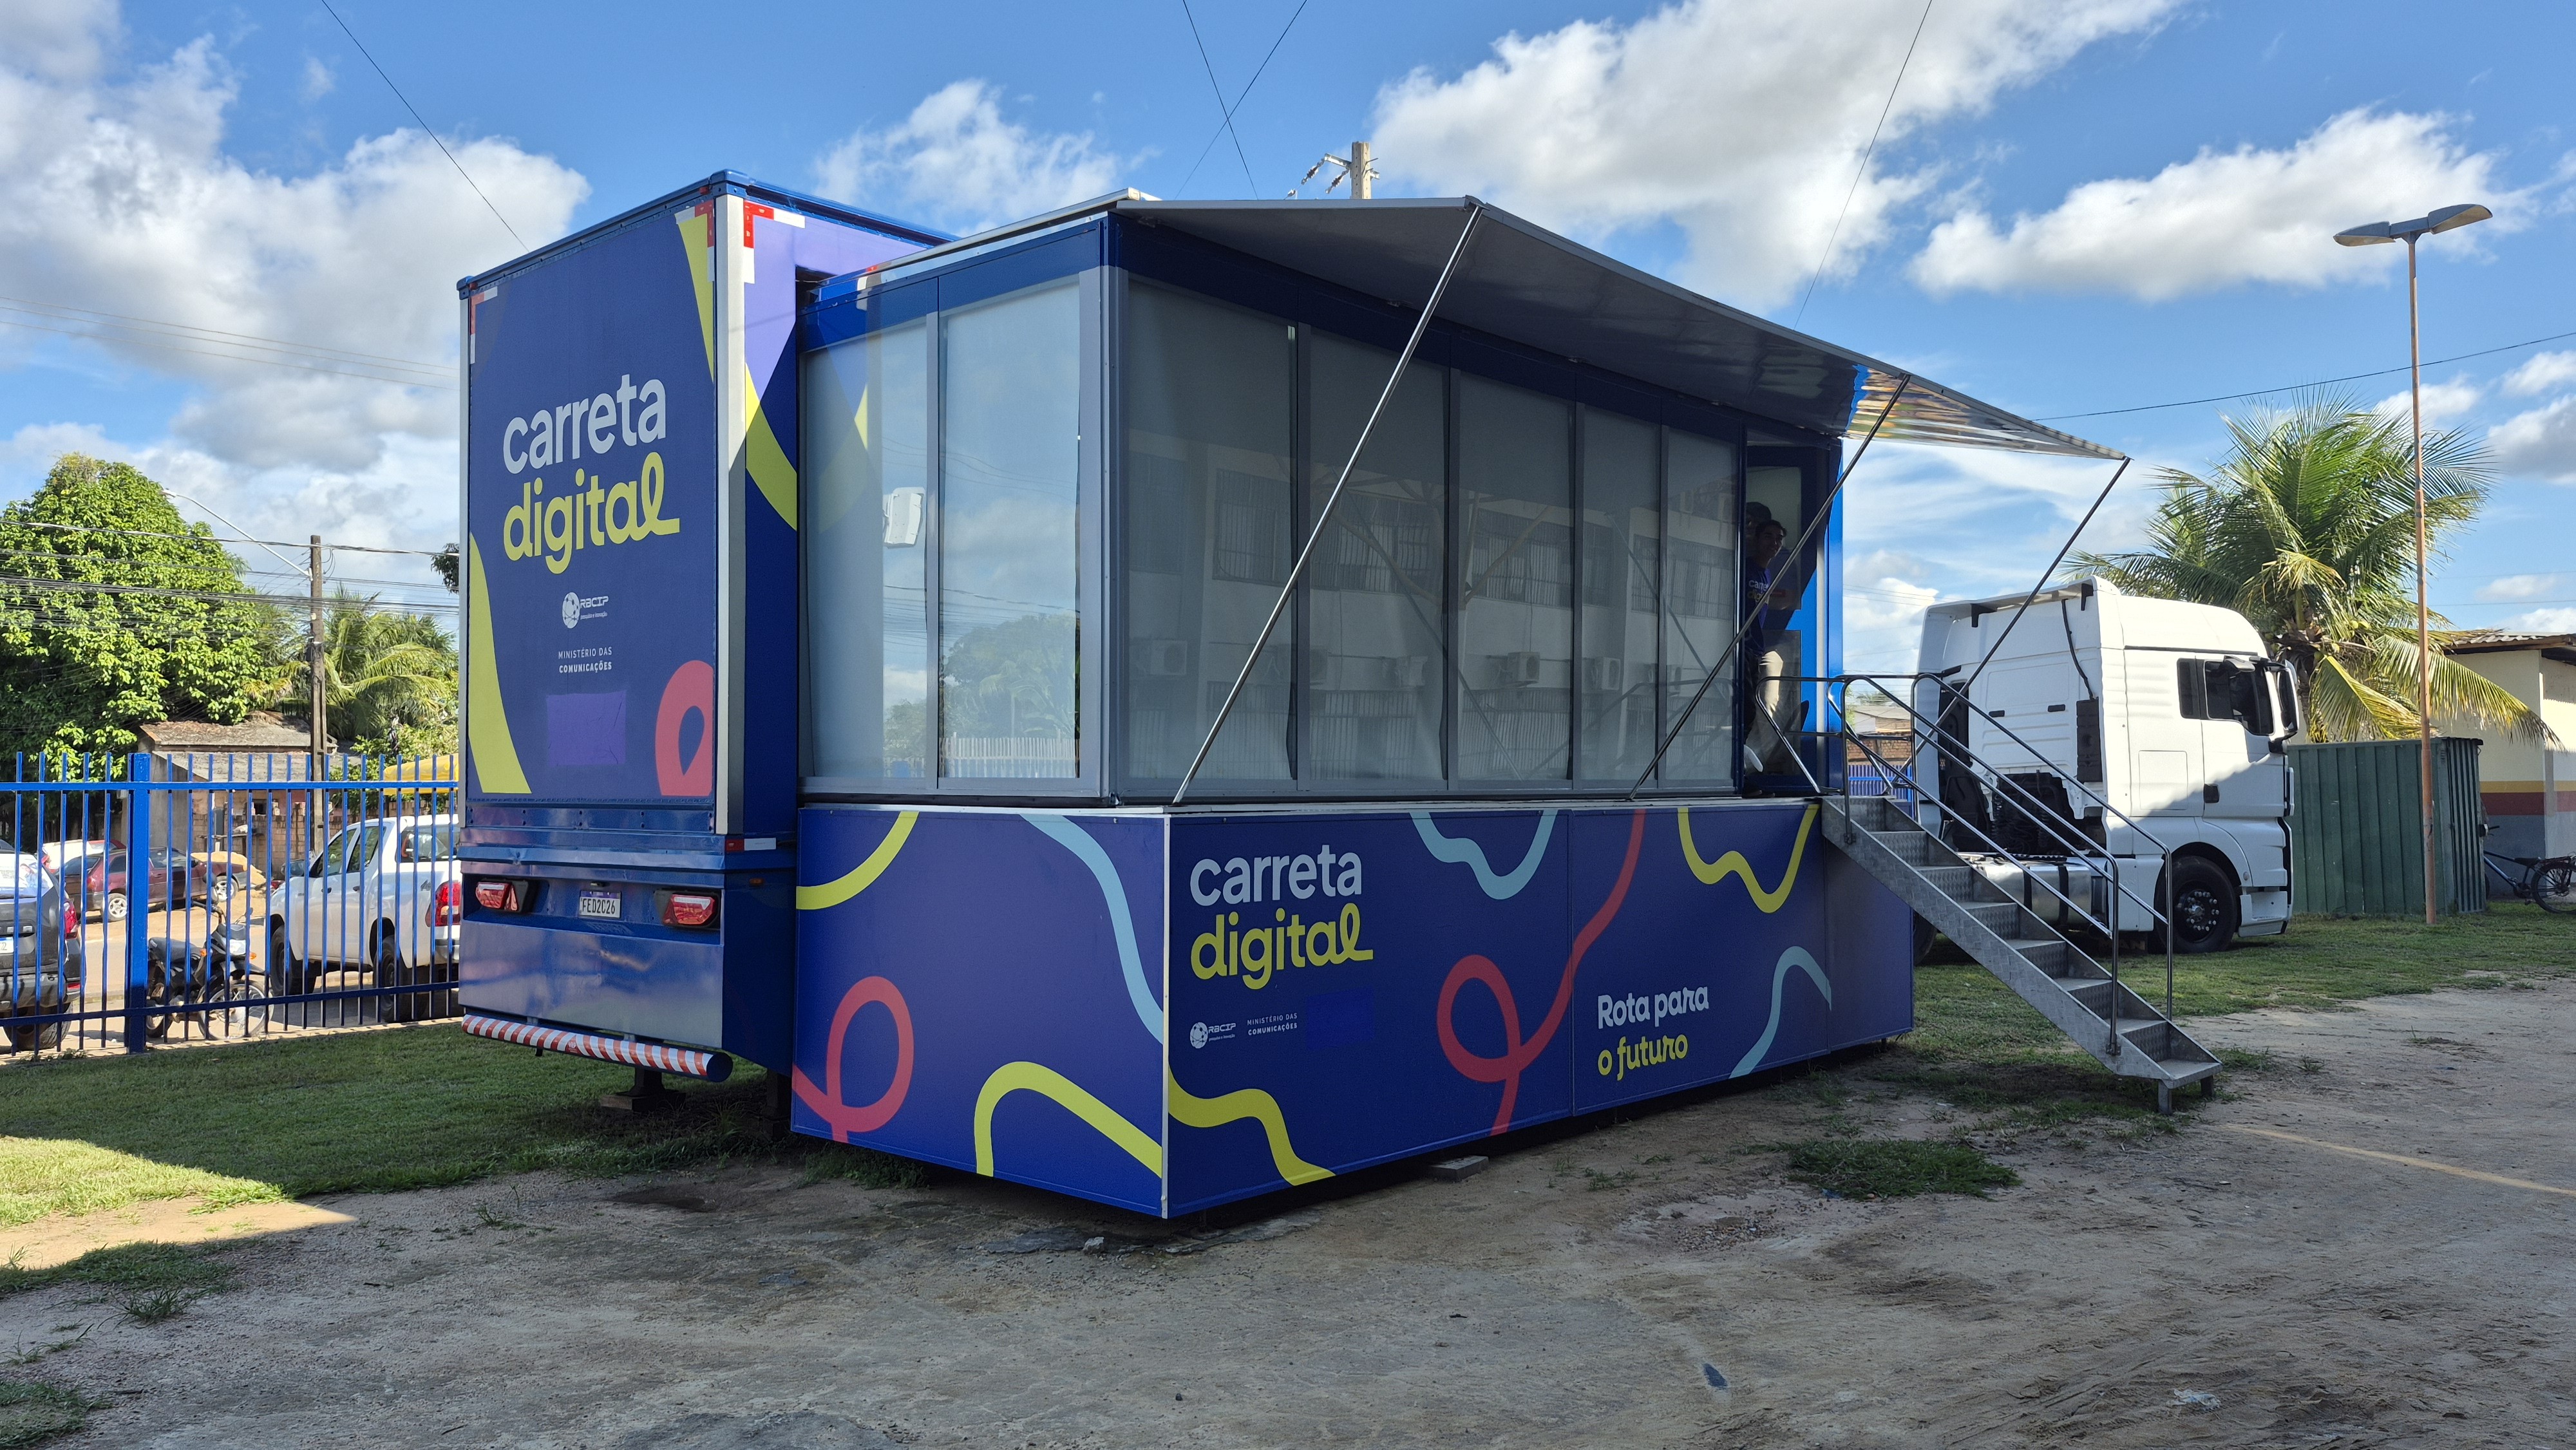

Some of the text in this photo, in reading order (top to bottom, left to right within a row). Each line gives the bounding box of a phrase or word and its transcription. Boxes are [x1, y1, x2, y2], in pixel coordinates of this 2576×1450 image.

[503, 373, 667, 475] carreta
[503, 451, 680, 574] digital
[558, 646, 612, 659] MINISTÉRIO DAS
[559, 660, 612, 673] COMUNICAÇÕES
[1190, 844, 1362, 907] carreta
[582, 898, 616, 914] FED2C26
[1191, 903, 1374, 990] digital
[1247, 1012, 1298, 1026] MINISTÉRIO DAS
[1247, 1022, 1298, 1036] COMUNICAÇÕES
[1598, 986, 1709, 1029] Rota para
[1598, 1034, 1689, 1081] o futuro
